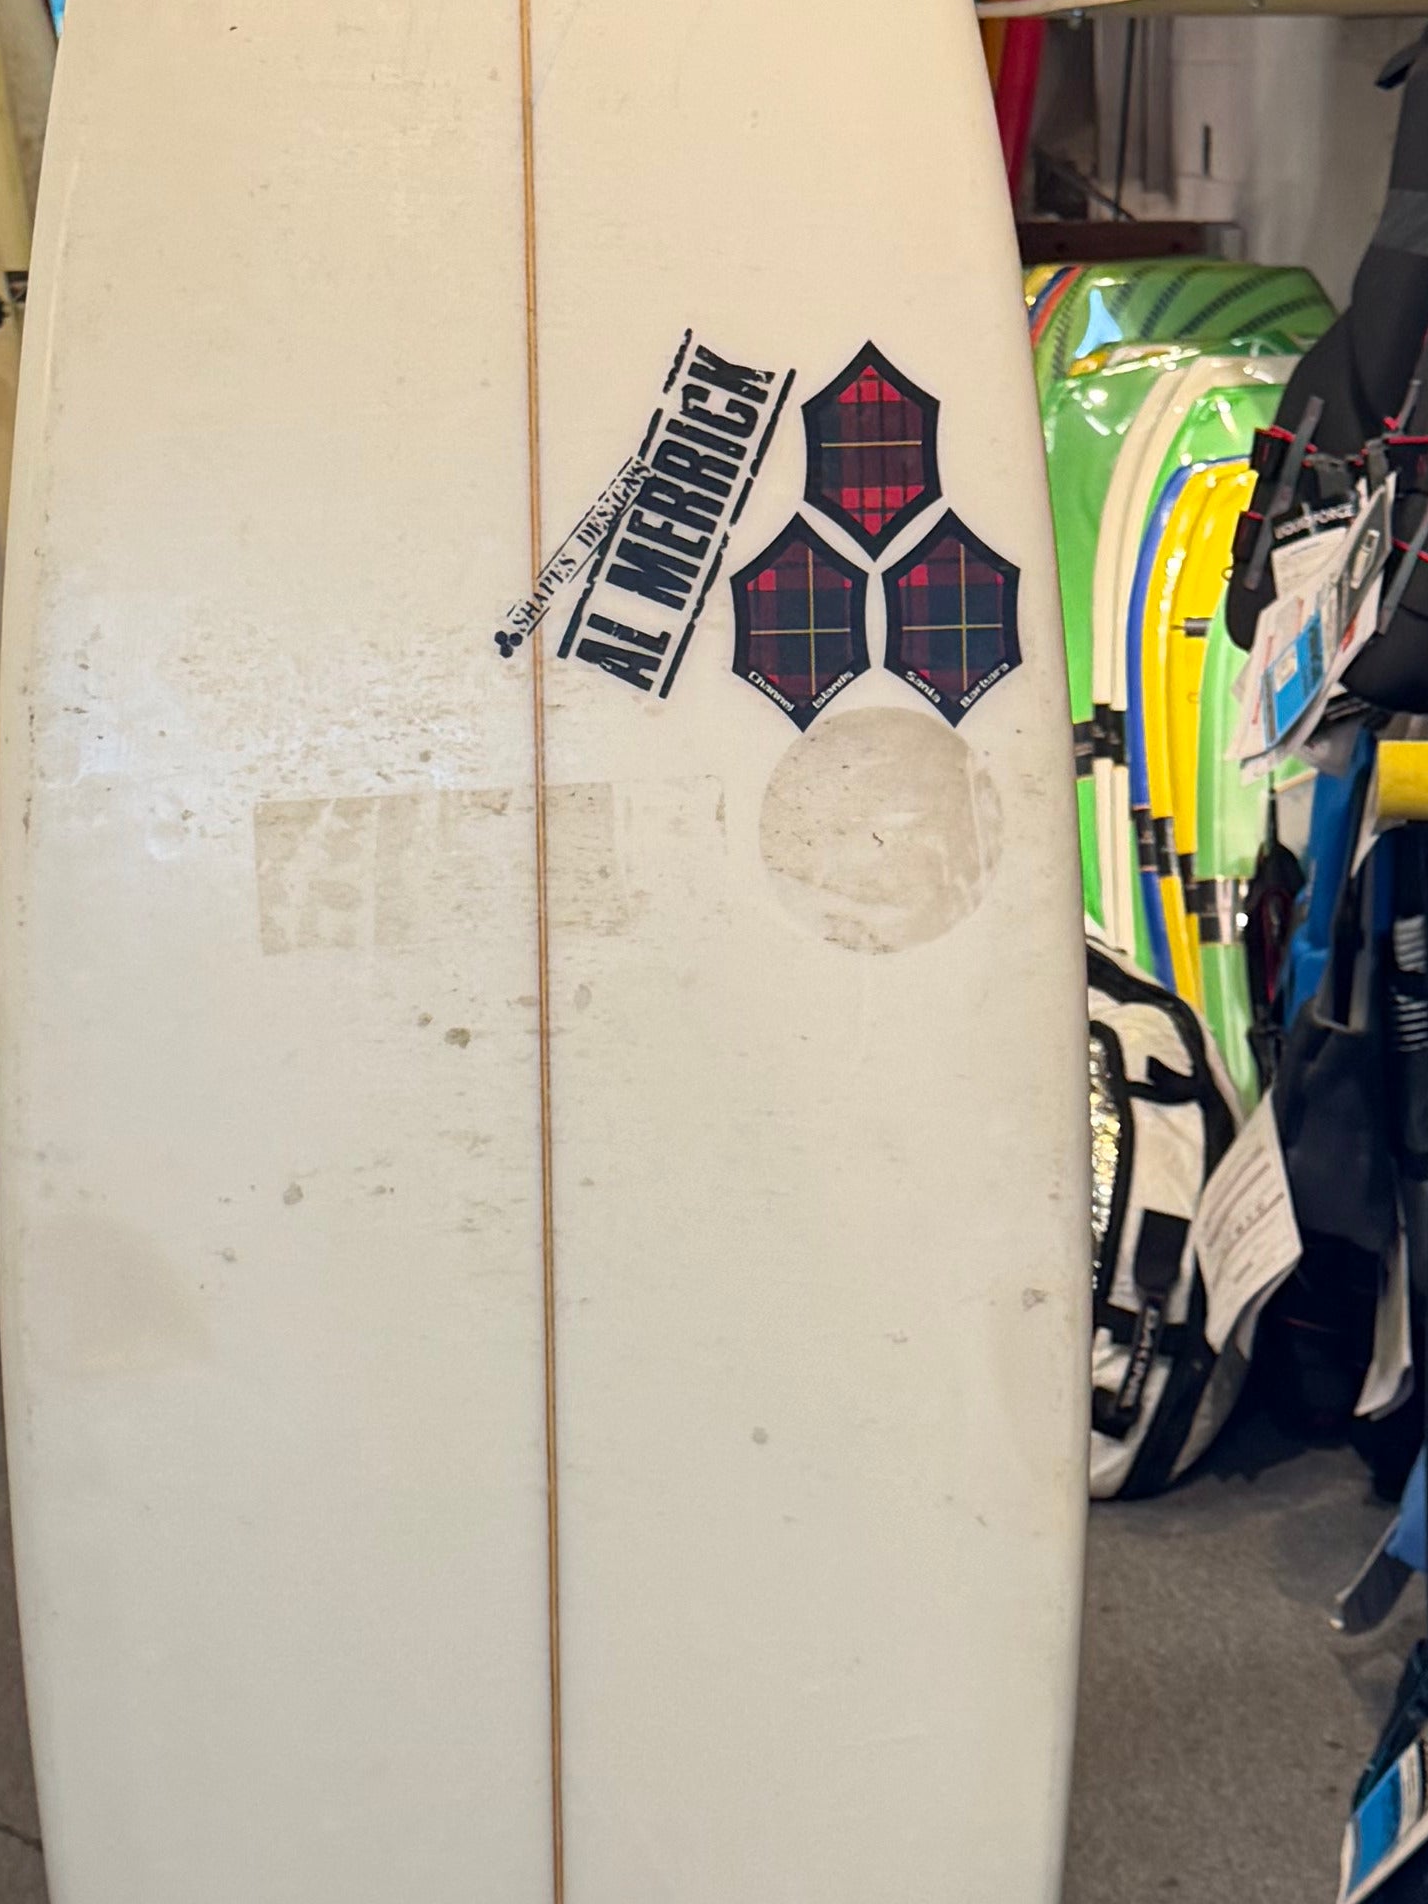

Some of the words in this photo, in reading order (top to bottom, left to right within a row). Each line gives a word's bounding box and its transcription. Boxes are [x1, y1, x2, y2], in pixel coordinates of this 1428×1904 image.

[604, 343, 777, 612] MERRICK
[510, 551, 578, 639] SHAPES
[575, 457, 654, 551] DESIGNS
[576, 613, 672, 693] AL
[747, 670, 795, 713] Channel
[959, 662, 1010, 709] Barbara
